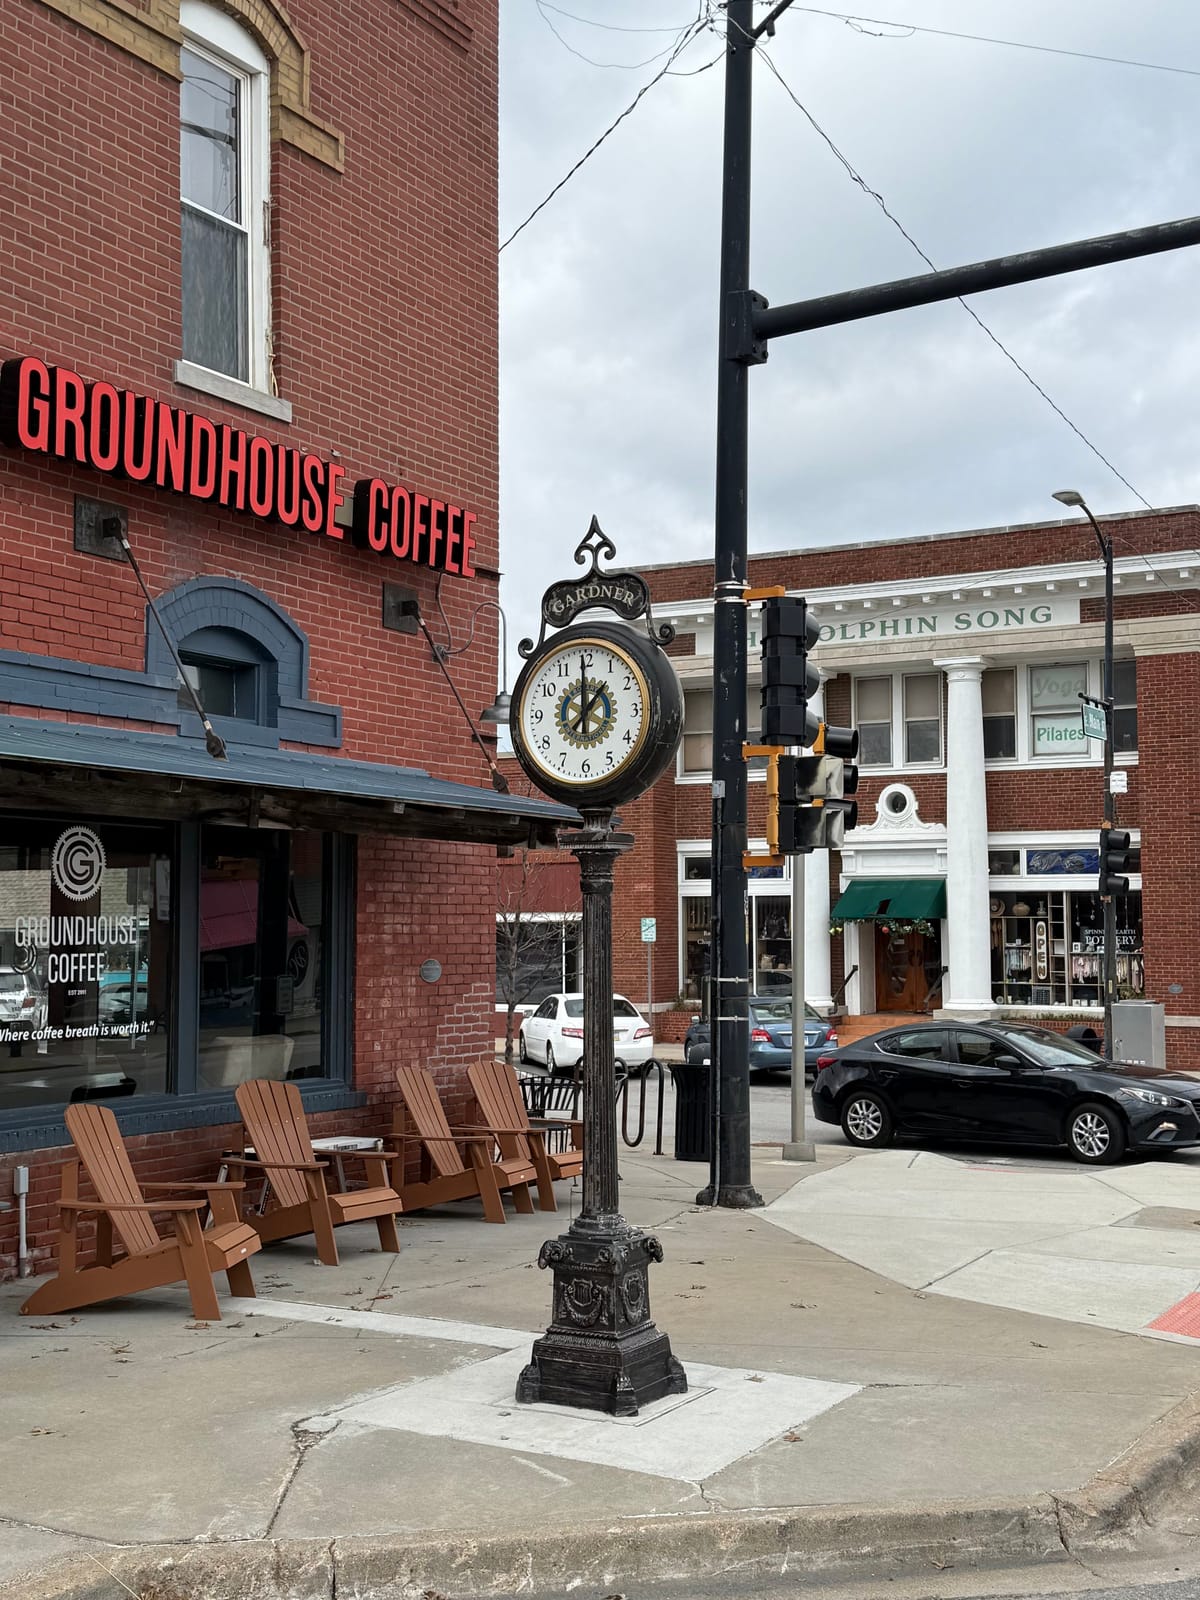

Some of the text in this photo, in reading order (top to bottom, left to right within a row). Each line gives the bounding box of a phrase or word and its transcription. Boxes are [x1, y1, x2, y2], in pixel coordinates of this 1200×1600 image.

[17, 356, 477, 578] GROUNDHOUSE COFFEE
[553, 585, 634, 612] GARDNER
[818, 605, 1052, 642] OLPHIN SONG
[579, 653, 594, 668] 12
[608, 659, 614, 673] 1
[557, 663, 570, 677] 11
[542, 682, 556, 697] 10
[623, 676, 632, 690] 2
[1034, 677, 1085, 698] Yoga
[535, 709, 544, 725] 9
[630, 702, 639, 718] 3
[622, 729, 632, 744] 4
[1037, 727, 1085, 741] Pilates
[541, 735, 551, 750] 8
[559, 752, 567, 767] 7
[581, 758, 591, 774] 6
[605, 751, 613, 766] 5
[15, 916, 138, 947] GROUNDHOUSE
[1085, 935, 1137, 945] POTERY
[48, 952, 105, 984] COFFEE
[31, 1025, 66, 1041] coffee
[65, 1023, 100, 1039] breath
[101, 1022, 109, 1036] is
[110, 1020, 139, 1035] worth
